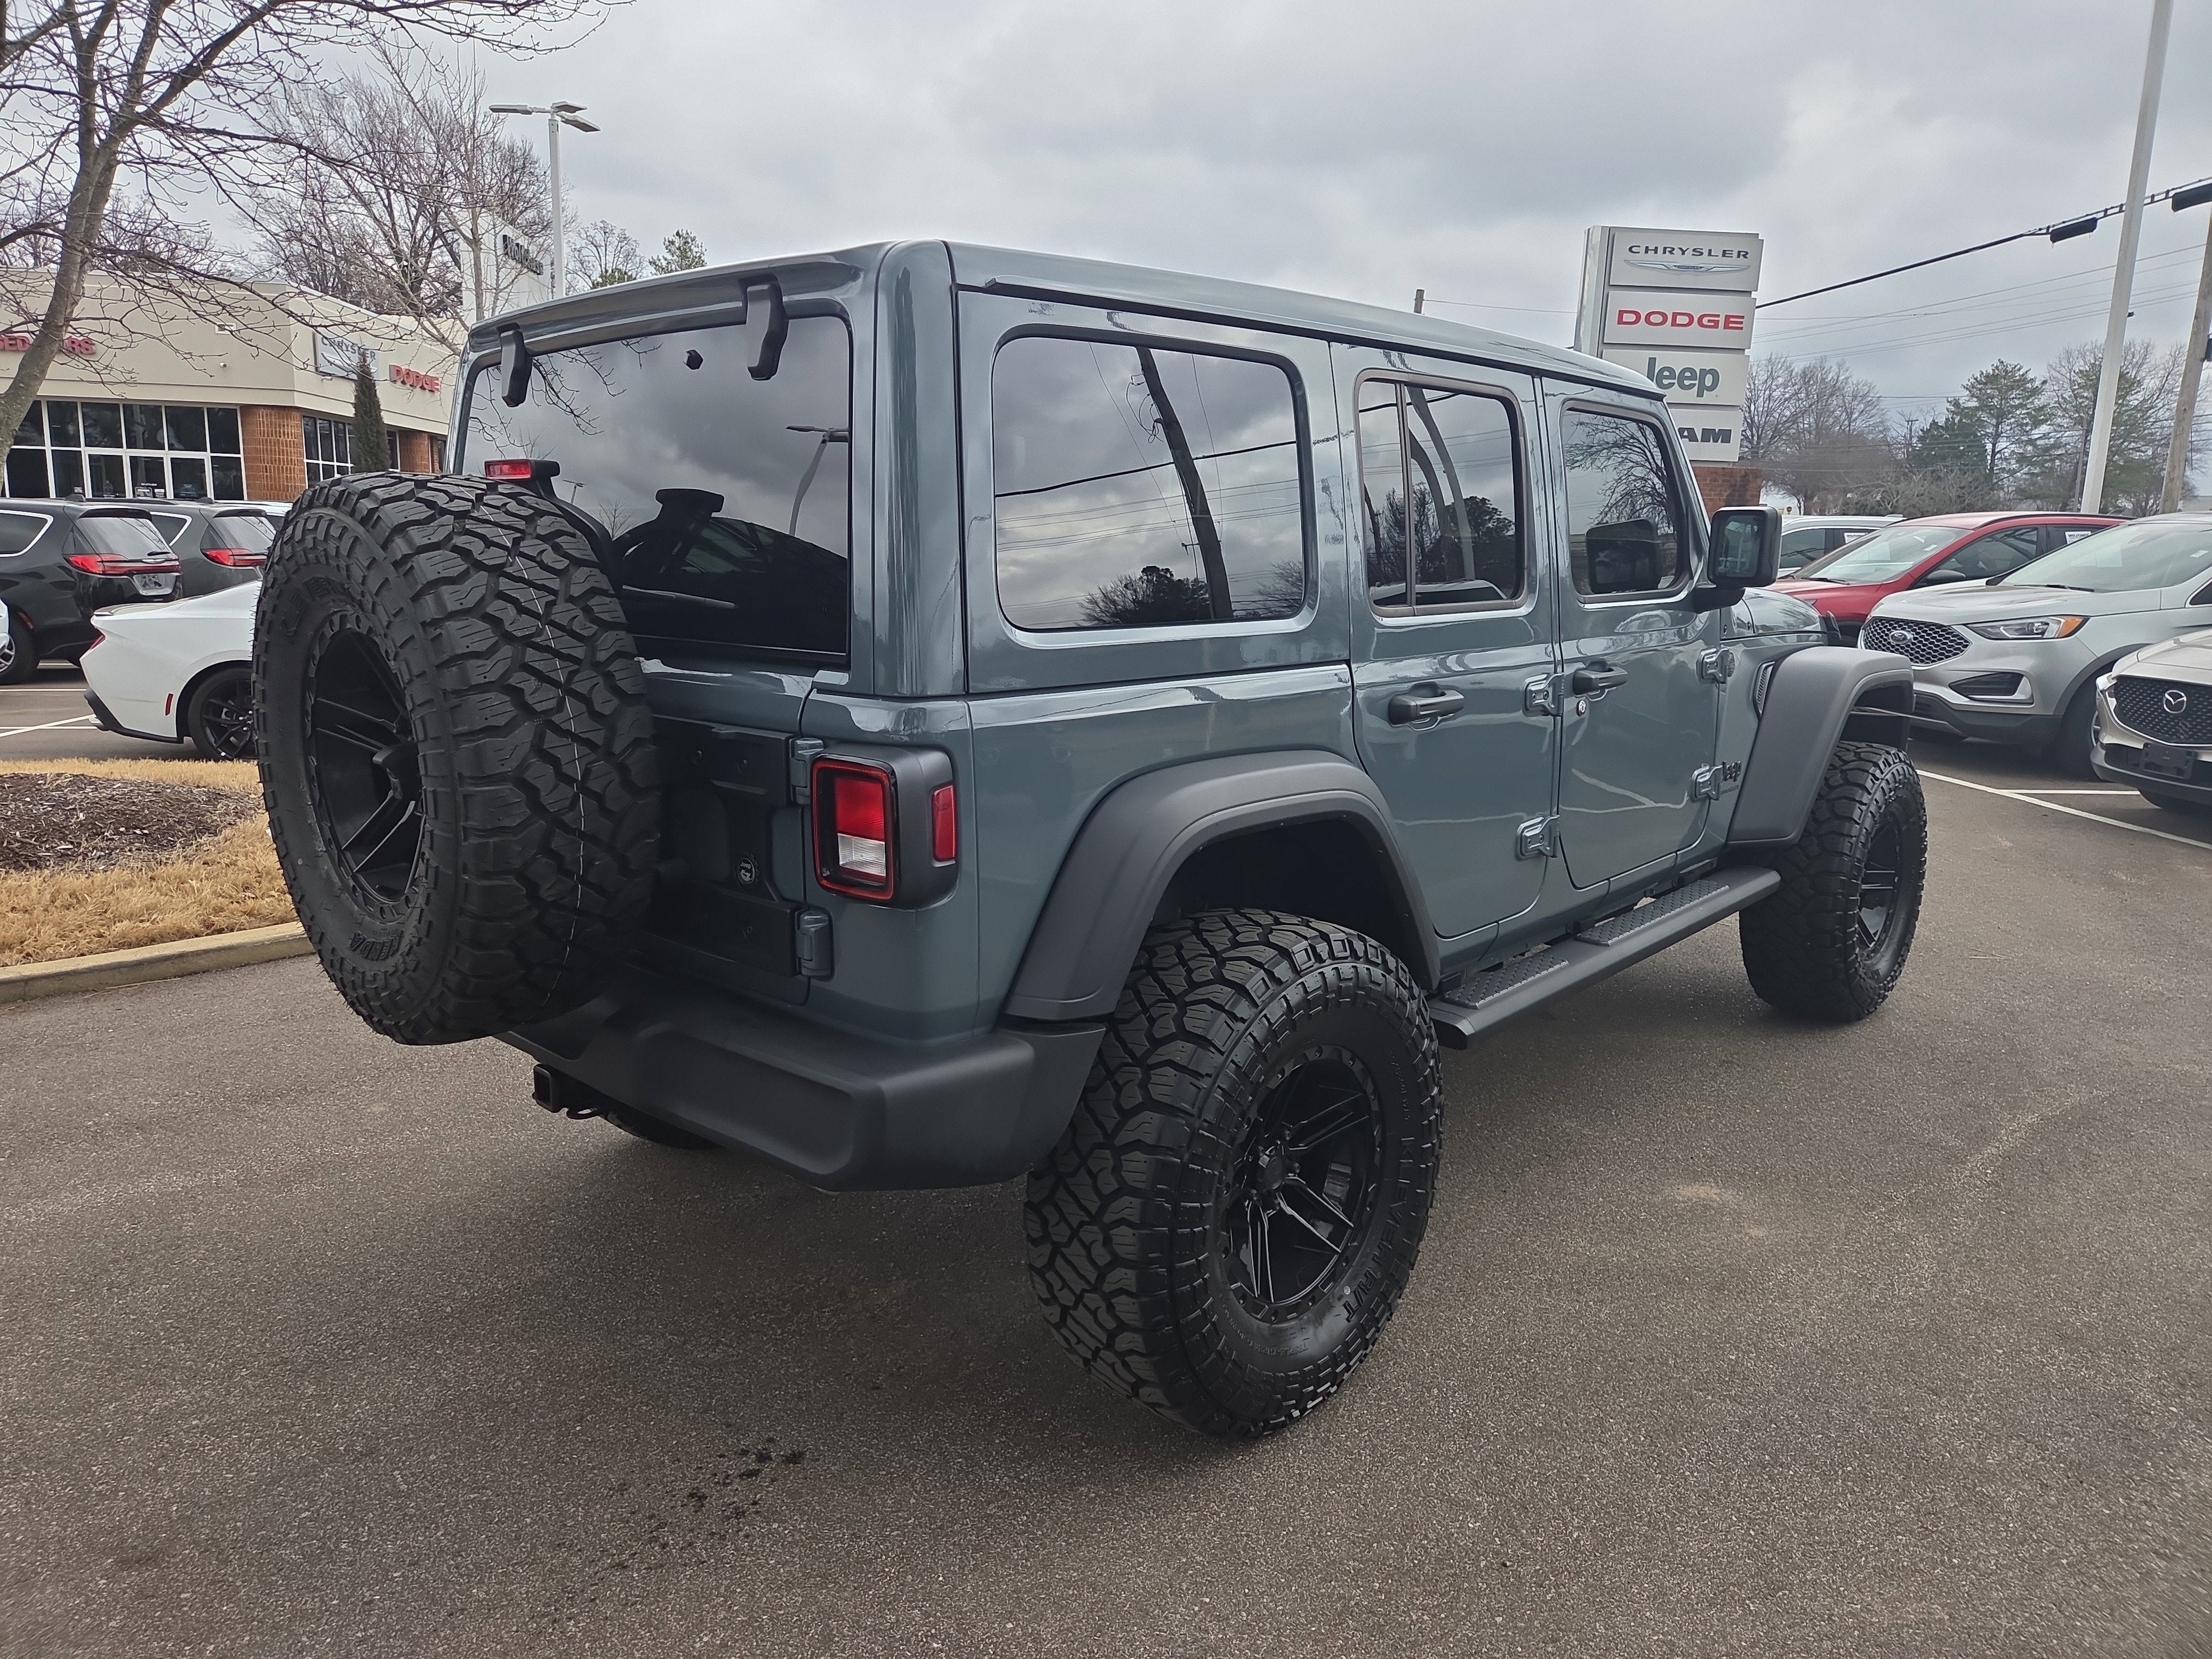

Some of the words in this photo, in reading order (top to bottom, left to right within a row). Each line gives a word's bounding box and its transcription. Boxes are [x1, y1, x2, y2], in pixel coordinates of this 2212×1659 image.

[1628, 245, 1749, 259] CHRYSLER
[1617, 310, 1745, 331] DODGE
[390, 364, 440, 391] DODGE
[1678, 427, 1732, 443] AM
